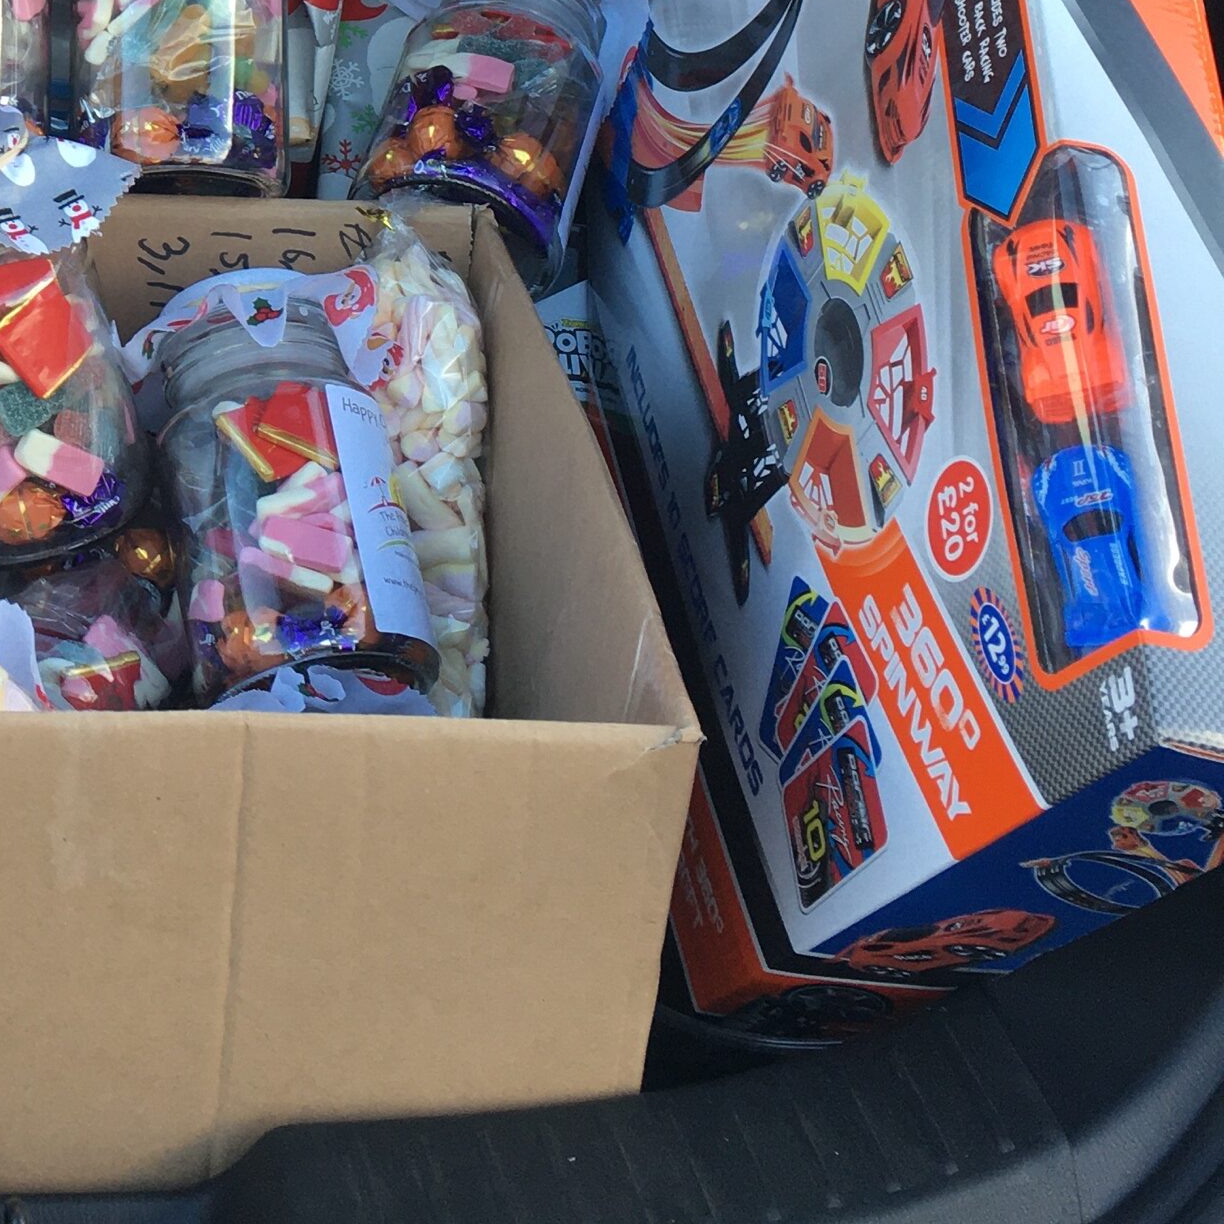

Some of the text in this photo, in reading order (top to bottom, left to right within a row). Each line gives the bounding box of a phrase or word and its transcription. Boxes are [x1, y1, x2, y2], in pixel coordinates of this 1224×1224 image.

[973, 0, 988, 38] BACK
[994, 25, 1008, 59] TWO
[961, 51, 976, 83] CARS
[978, 36, 995, 84] RACING
[937, 489, 965, 562] £20
[957, 476, 981, 545] 2 for
[712, 651, 764, 798] CARDS
[857, 593, 973, 822] SPINWAY
[1099, 675, 1121, 752] YEARS
[1110, 665, 1140, 742] 3+
[802, 798, 827, 863] 10
